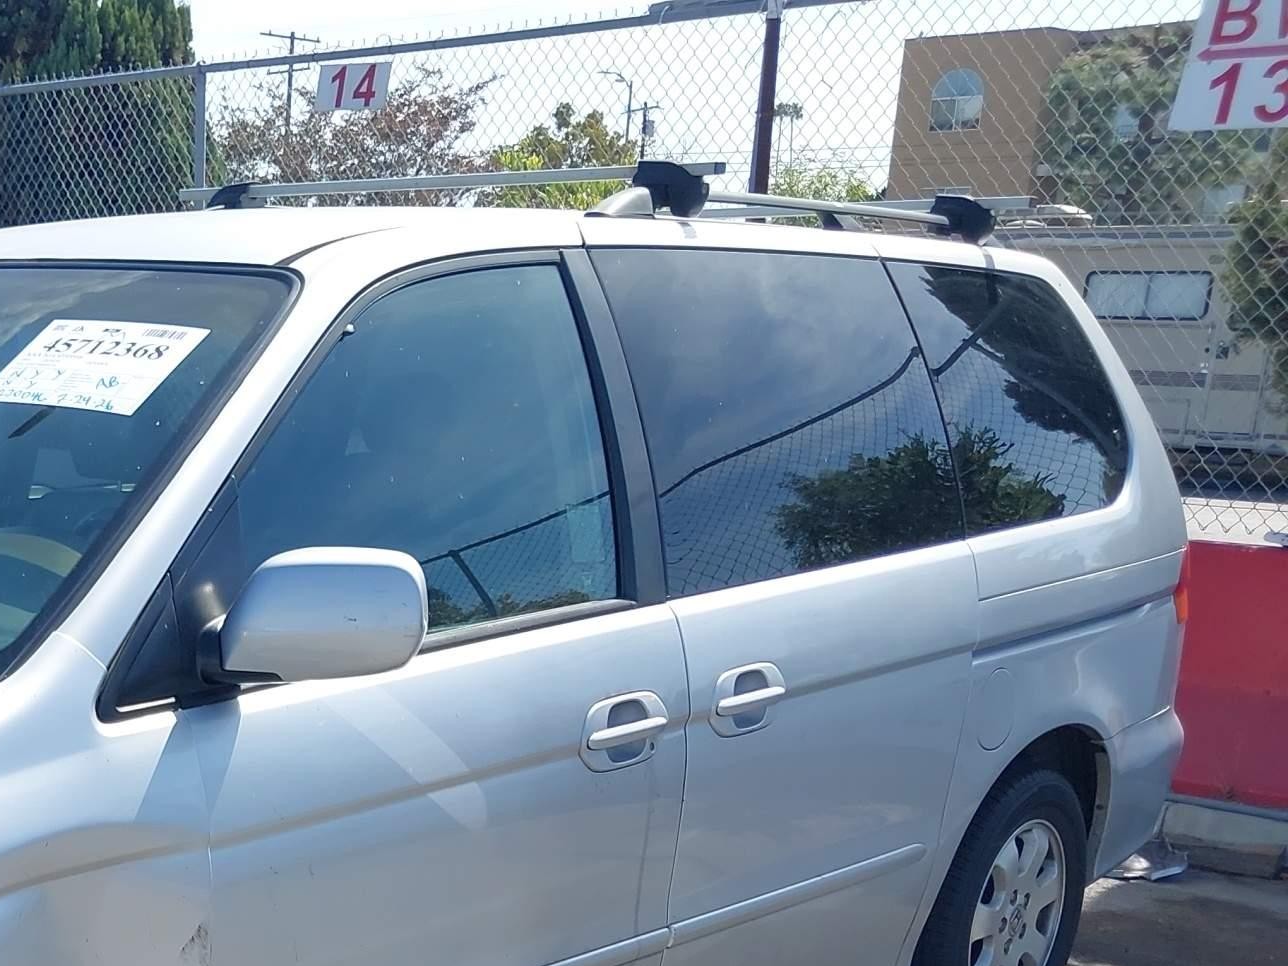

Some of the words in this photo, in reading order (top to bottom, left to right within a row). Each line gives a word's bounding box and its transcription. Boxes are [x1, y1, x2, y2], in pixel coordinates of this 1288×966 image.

[331, 63, 377, 109] 14
[1209, 60, 1288, 125] 13
[43, 337, 170, 361] 45712368
